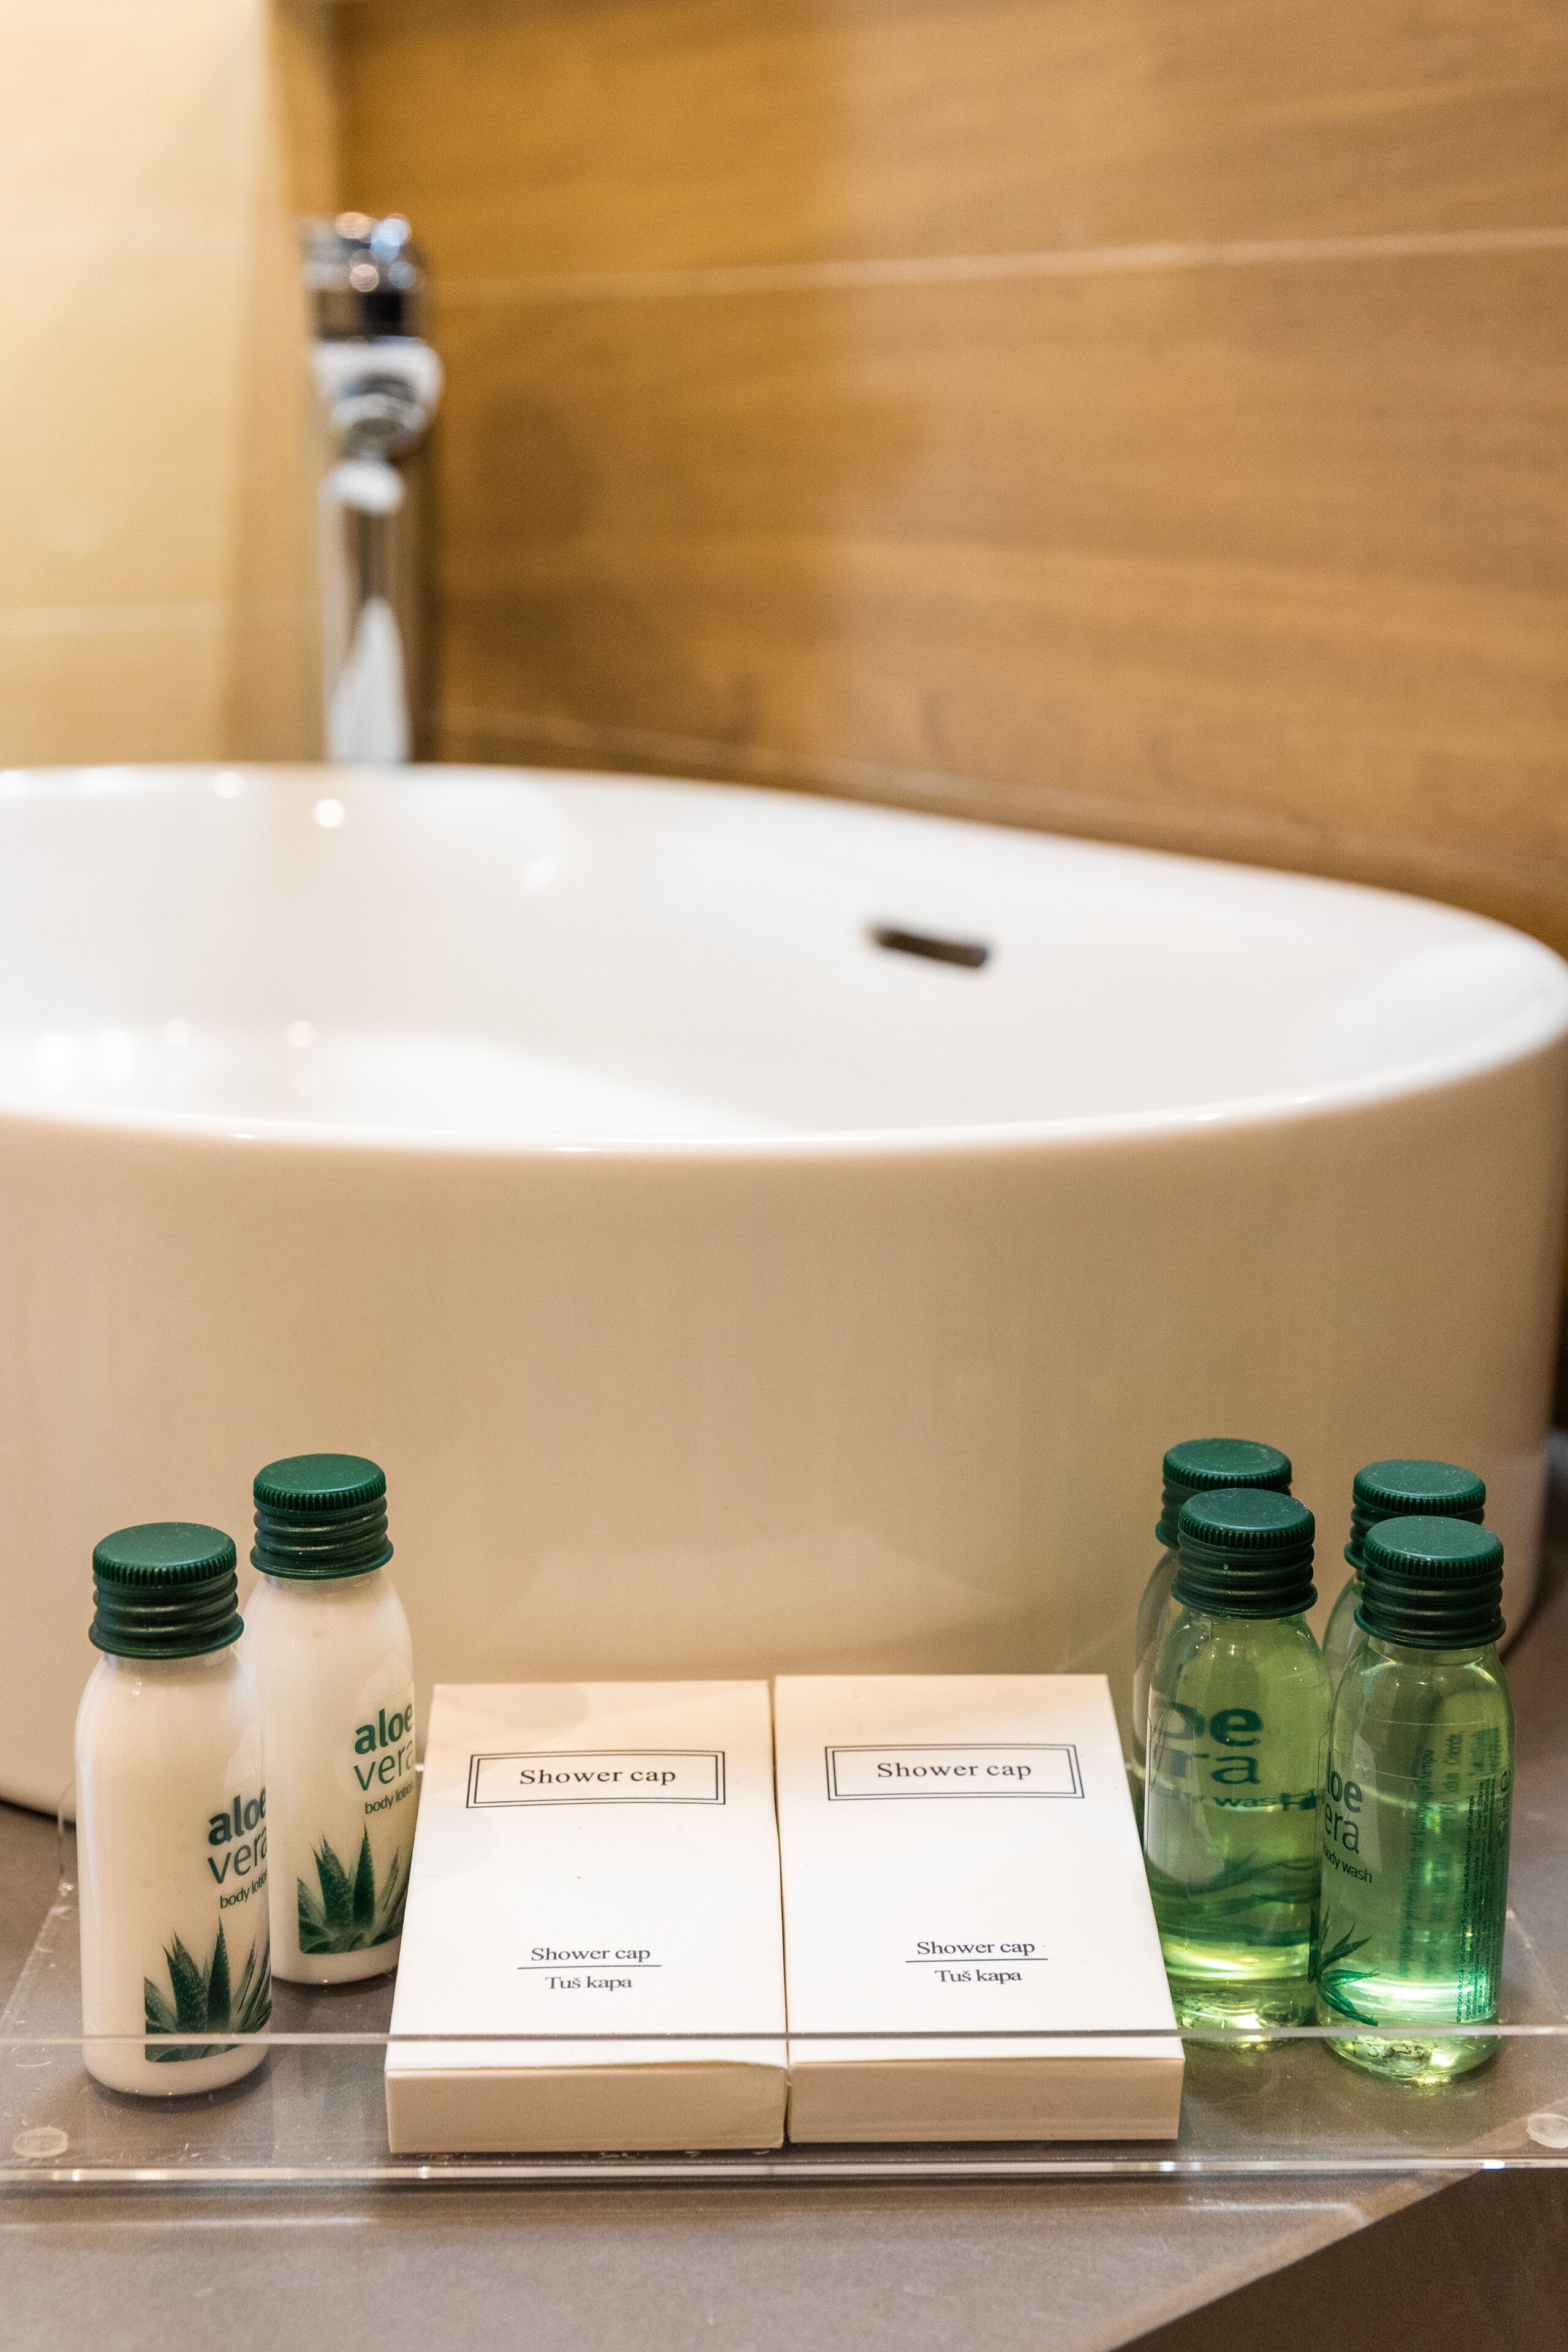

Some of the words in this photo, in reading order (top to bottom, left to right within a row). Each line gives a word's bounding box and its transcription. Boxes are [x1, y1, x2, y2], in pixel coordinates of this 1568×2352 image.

[355, 1703, 413, 1755] aloe
[354, 1740, 414, 1792] vera
[519, 1769, 623, 1785] Shower
[630, 1769, 676, 1785] cap
[877, 1762, 979, 1777] Shower
[987, 1762, 1032, 1779] cap
[1327, 1751, 1363, 1814] loe
[365, 1795, 394, 1815] body
[208, 1787, 266, 1846] aloe
[1325, 1803, 1360, 1855] era
[208, 1826, 267, 1885] vera
[1341, 1860, 1373, 1883] wash
[221, 1887, 250, 1909] body
[531, 1947, 611, 1961] Shower
[615, 1947, 651, 1962] cap
[917, 1941, 995, 1954] Shower
[1000, 1941, 1036, 1956] cap
[545, 1976, 581, 1989] Tuš
[586, 1975, 633, 1991] kapa
[935, 1970, 971, 1983] Tuš
[975, 1969, 1023, 1985] kapa
